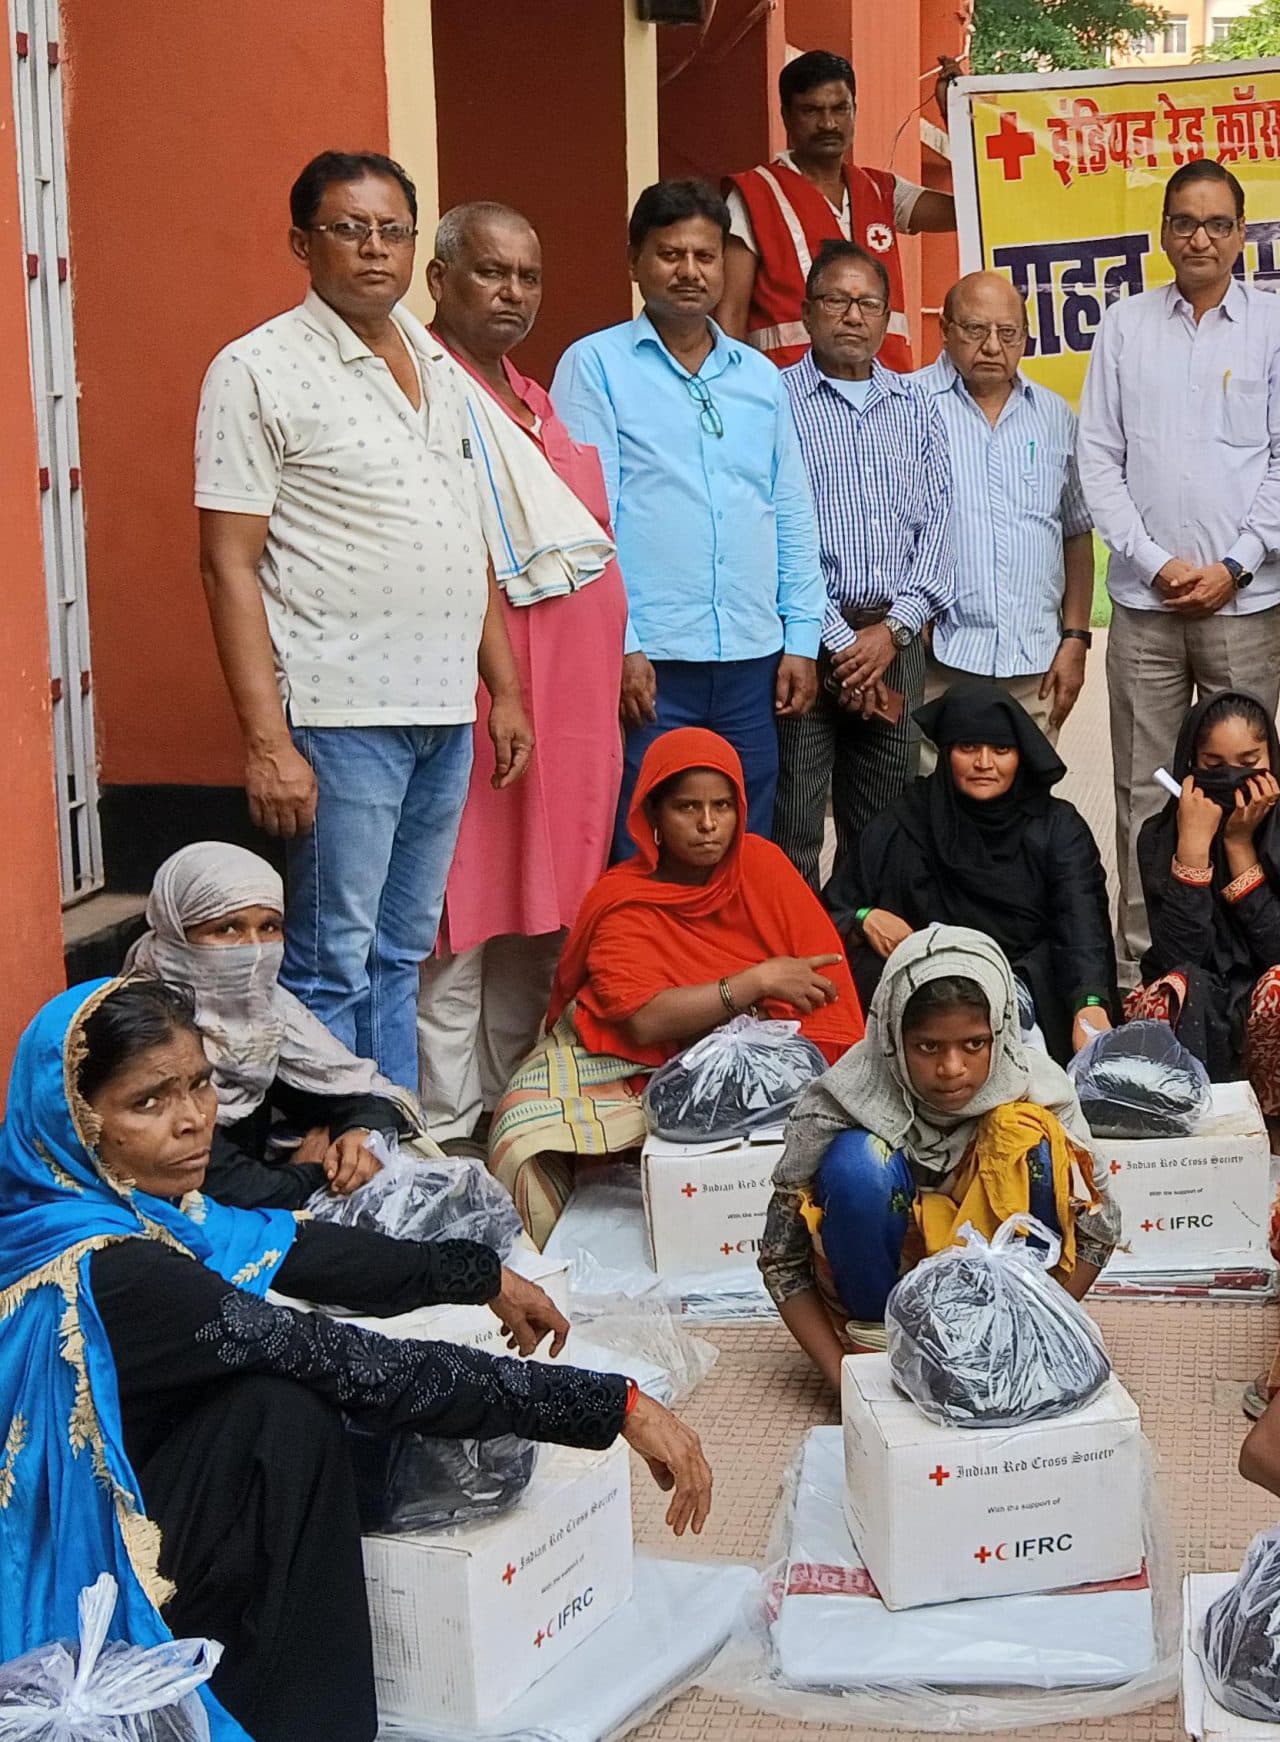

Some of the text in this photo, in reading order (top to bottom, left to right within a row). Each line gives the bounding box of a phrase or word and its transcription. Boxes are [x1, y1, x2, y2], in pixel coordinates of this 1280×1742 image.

[1047, 97, 1158, 188] इंडियन
[1157, 92, 1206, 166] रेड
[993, 234, 1150, 358] राहत
[1126, 1155, 1244, 1170] Indian Red Cross Society
[701, 1183, 735, 1193] Indian
[738, 1179, 757, 1190] Red
[1170, 1214, 1214, 1230] IFRC
[956, 1449, 1115, 1478] Indian Red Cross Society
[987, 1497, 1061, 1514] With the support of
[520, 1543, 547, 1570] Indian
[566, 1510, 589, 1534] Cross
[1015, 1533, 1073, 1558] IFRC
[558, 1586, 594, 1631] IFRC
